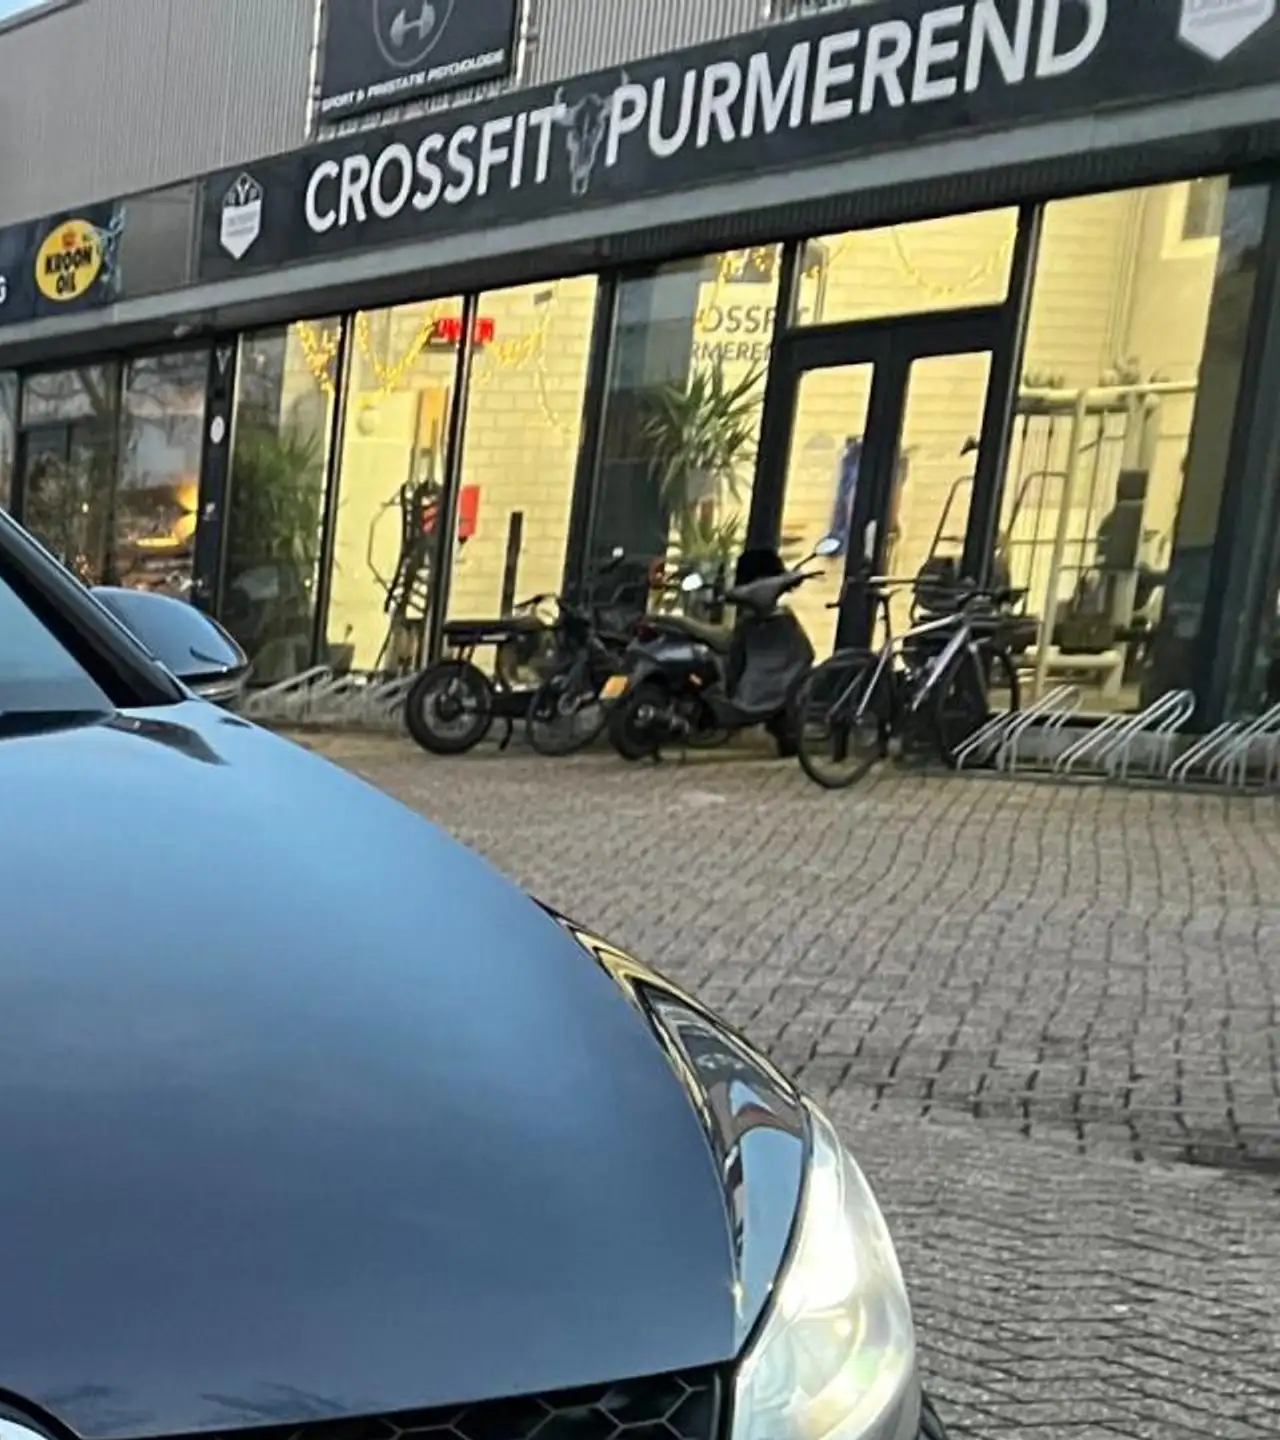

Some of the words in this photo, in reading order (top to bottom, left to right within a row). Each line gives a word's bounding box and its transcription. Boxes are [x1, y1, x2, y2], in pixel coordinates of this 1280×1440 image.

[305, 102, 567, 232] CROSSFIT
[604, 0, 1107, 167] PURMEREND
[44, 246, 94, 276] KROON
[56, 272, 76, 296] OIL
